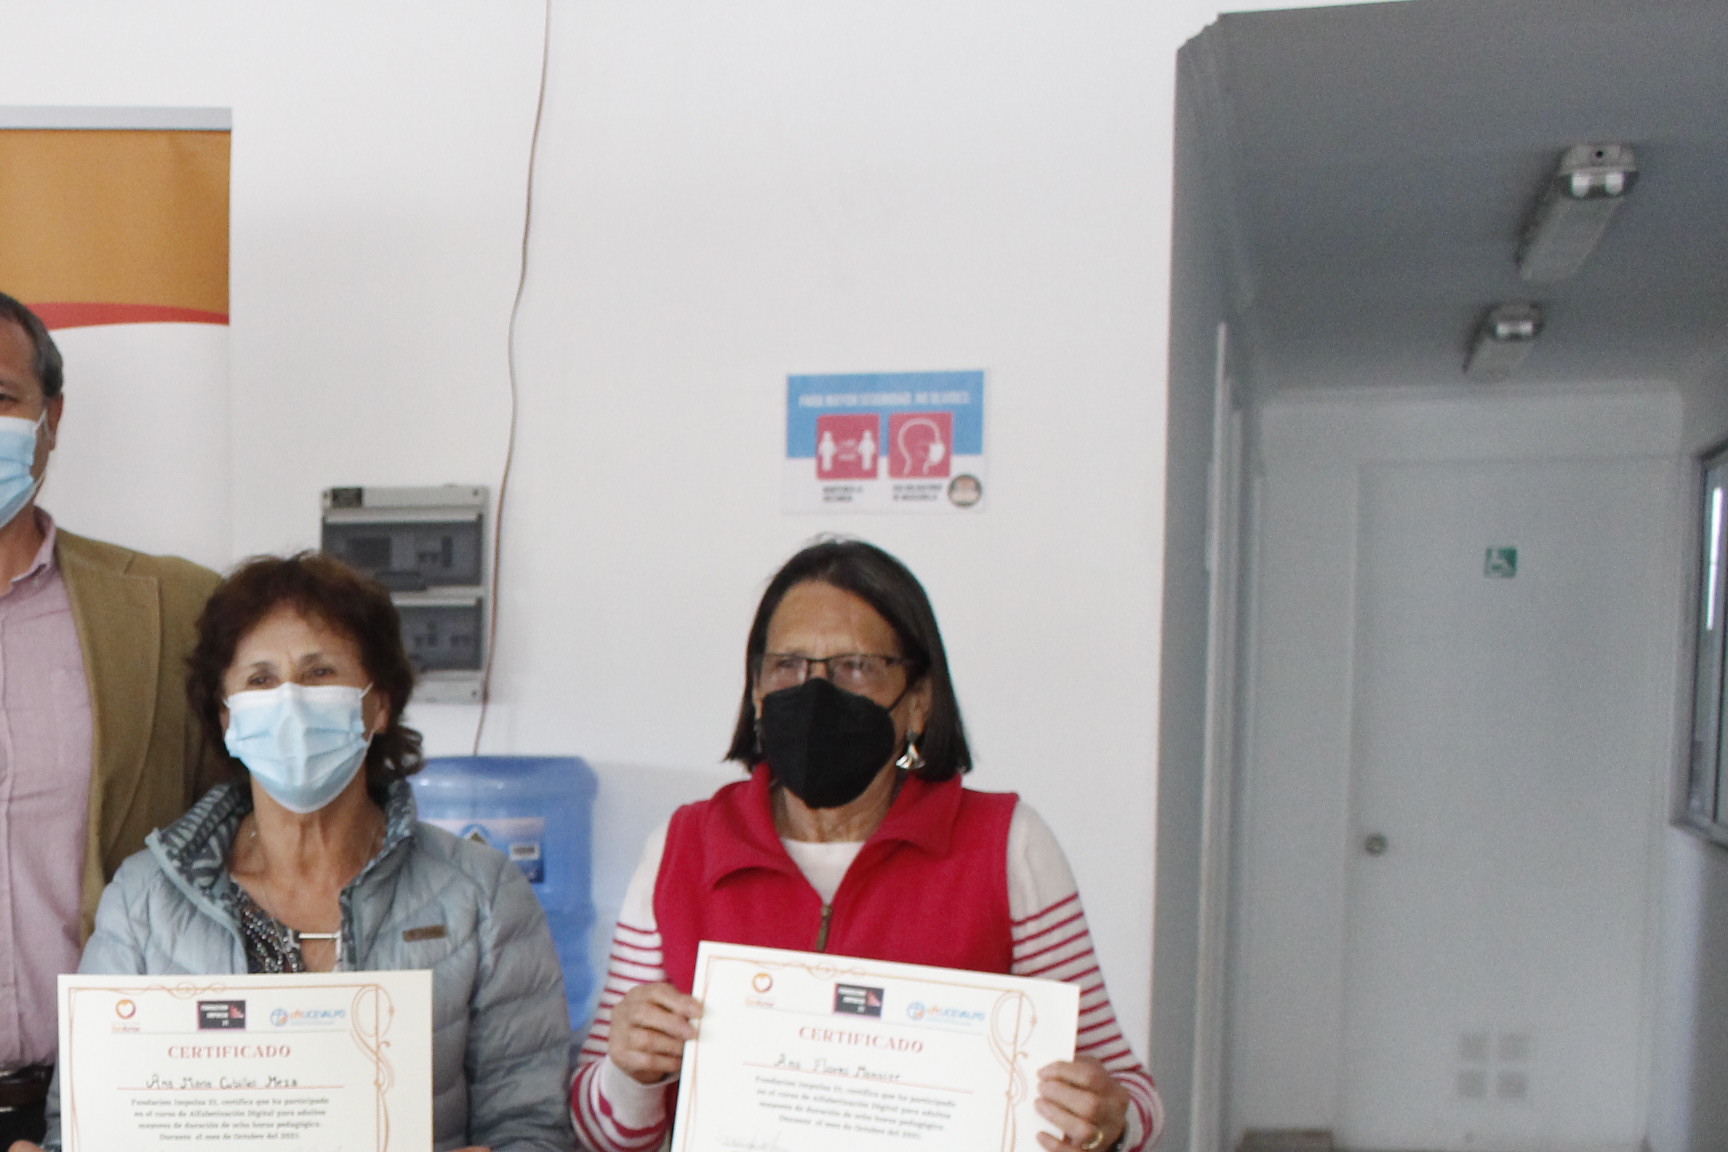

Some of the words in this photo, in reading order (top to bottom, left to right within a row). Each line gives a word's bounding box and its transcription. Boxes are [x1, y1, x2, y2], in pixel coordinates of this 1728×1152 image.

[798, 1026, 925, 1054] CERTIFICADO
[167, 1044, 292, 1059] CERTIFICADO
[145, 1072, 174, 1090] Ana
